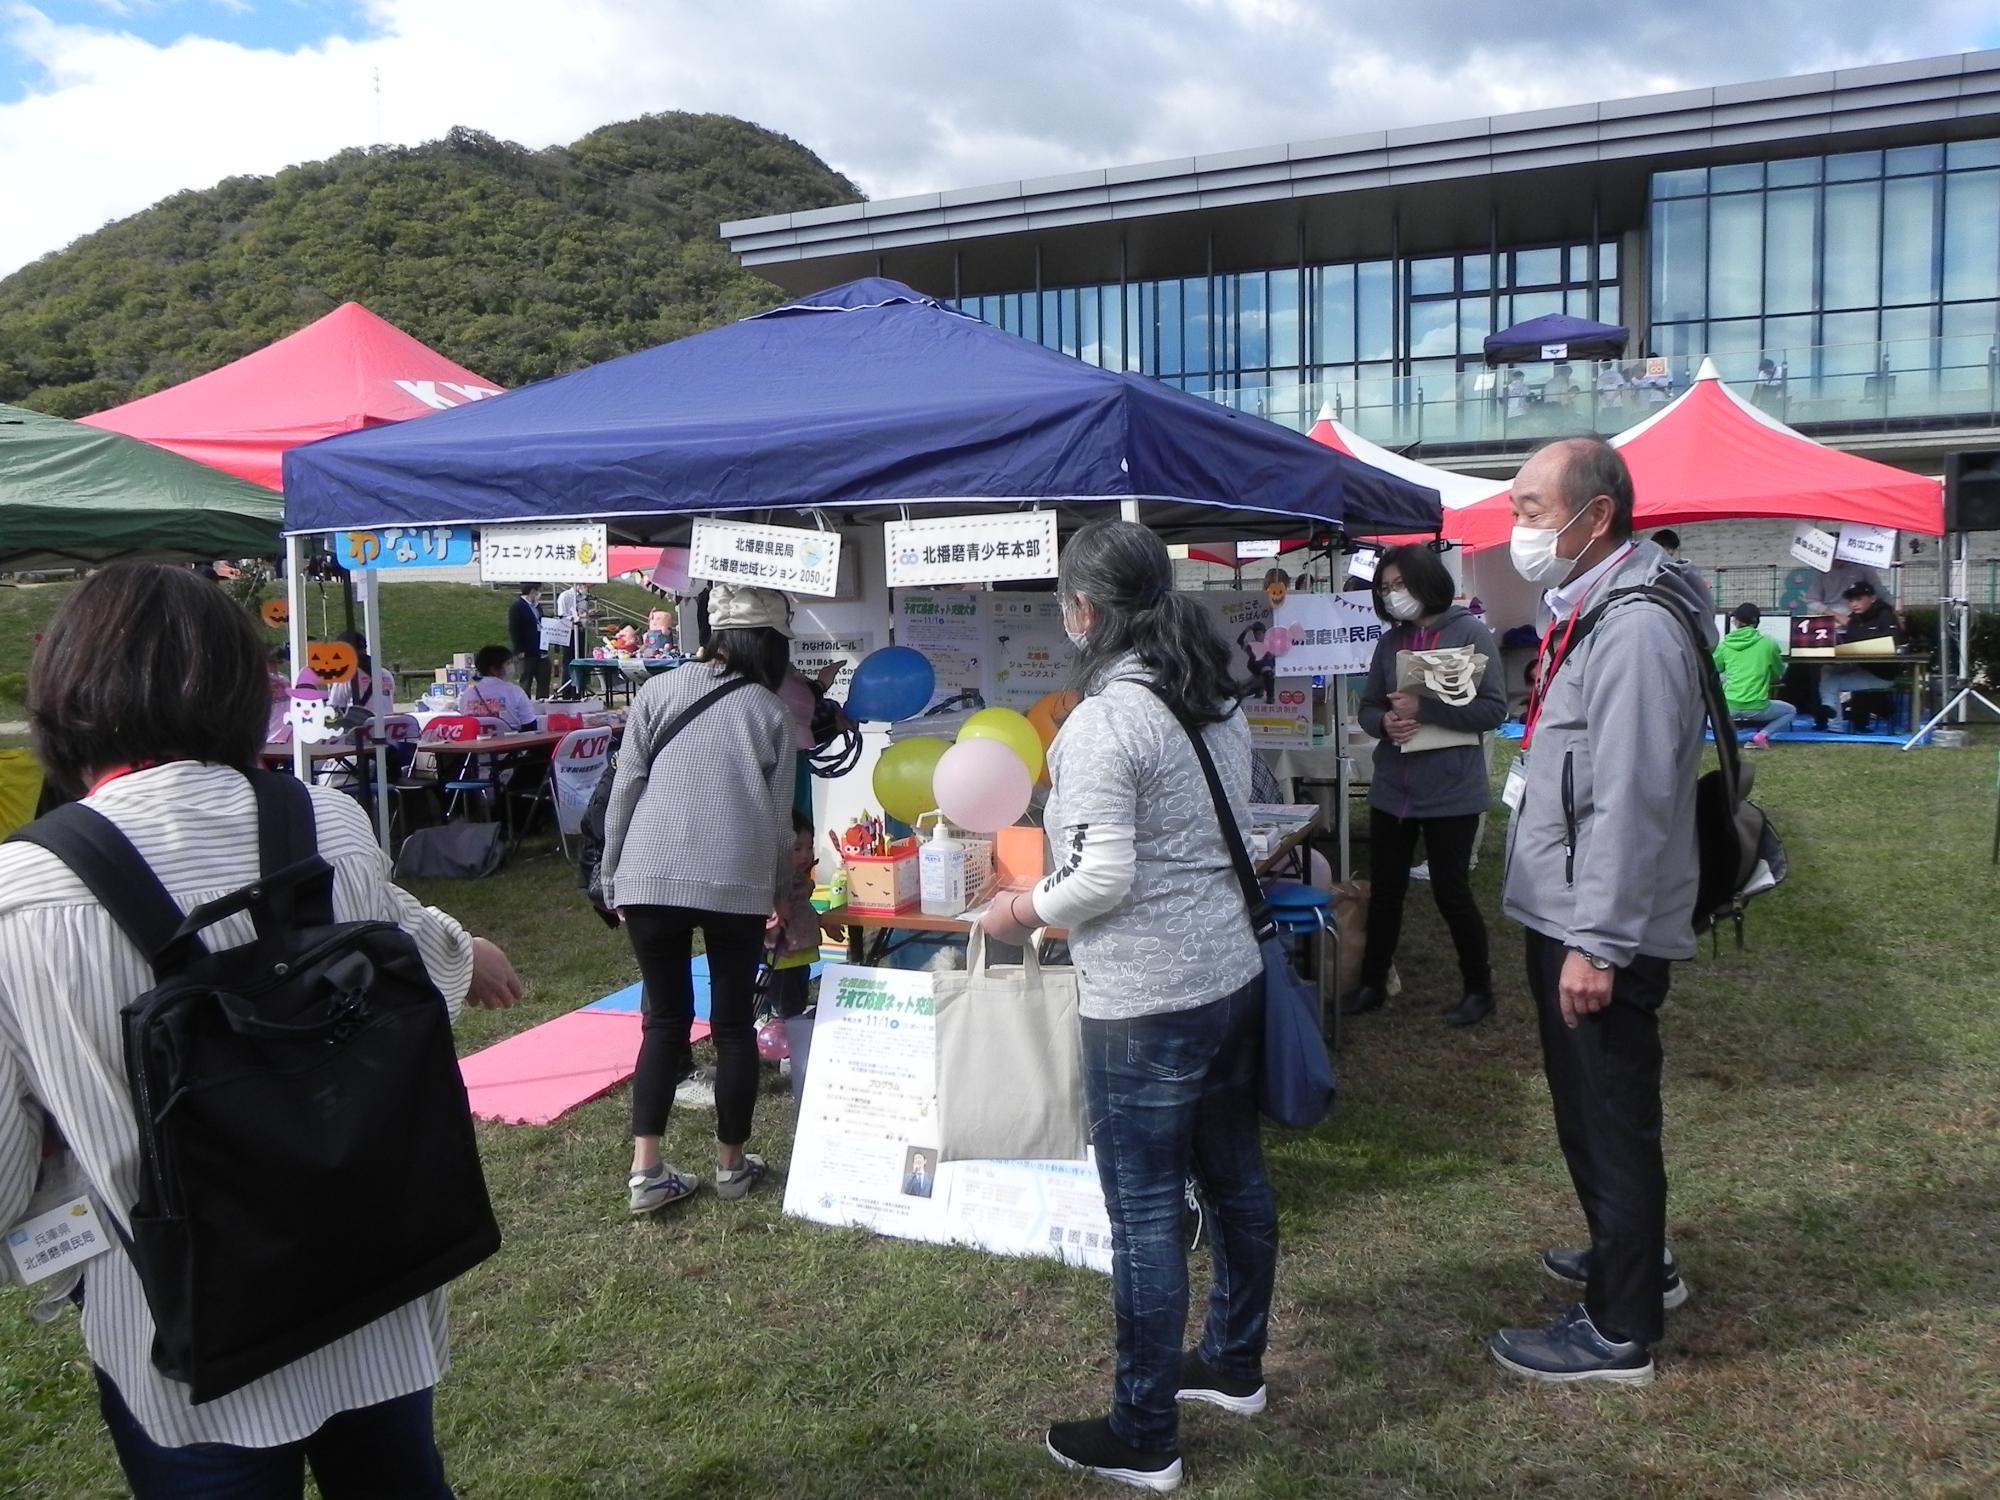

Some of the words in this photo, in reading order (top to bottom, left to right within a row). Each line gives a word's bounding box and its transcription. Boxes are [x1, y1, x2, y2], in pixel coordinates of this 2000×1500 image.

[489, 543, 577, 561] フェニックス共済
[735, 537, 794, 558] 北播磨県民局
[922, 540, 1041, 566] 北播磨青少年本部
[704, 554, 797, 580] 「北播磨地域ビジョン
[1292, 624, 1383, 647] 播磨県民局
[569, 735, 610, 759] KYC
